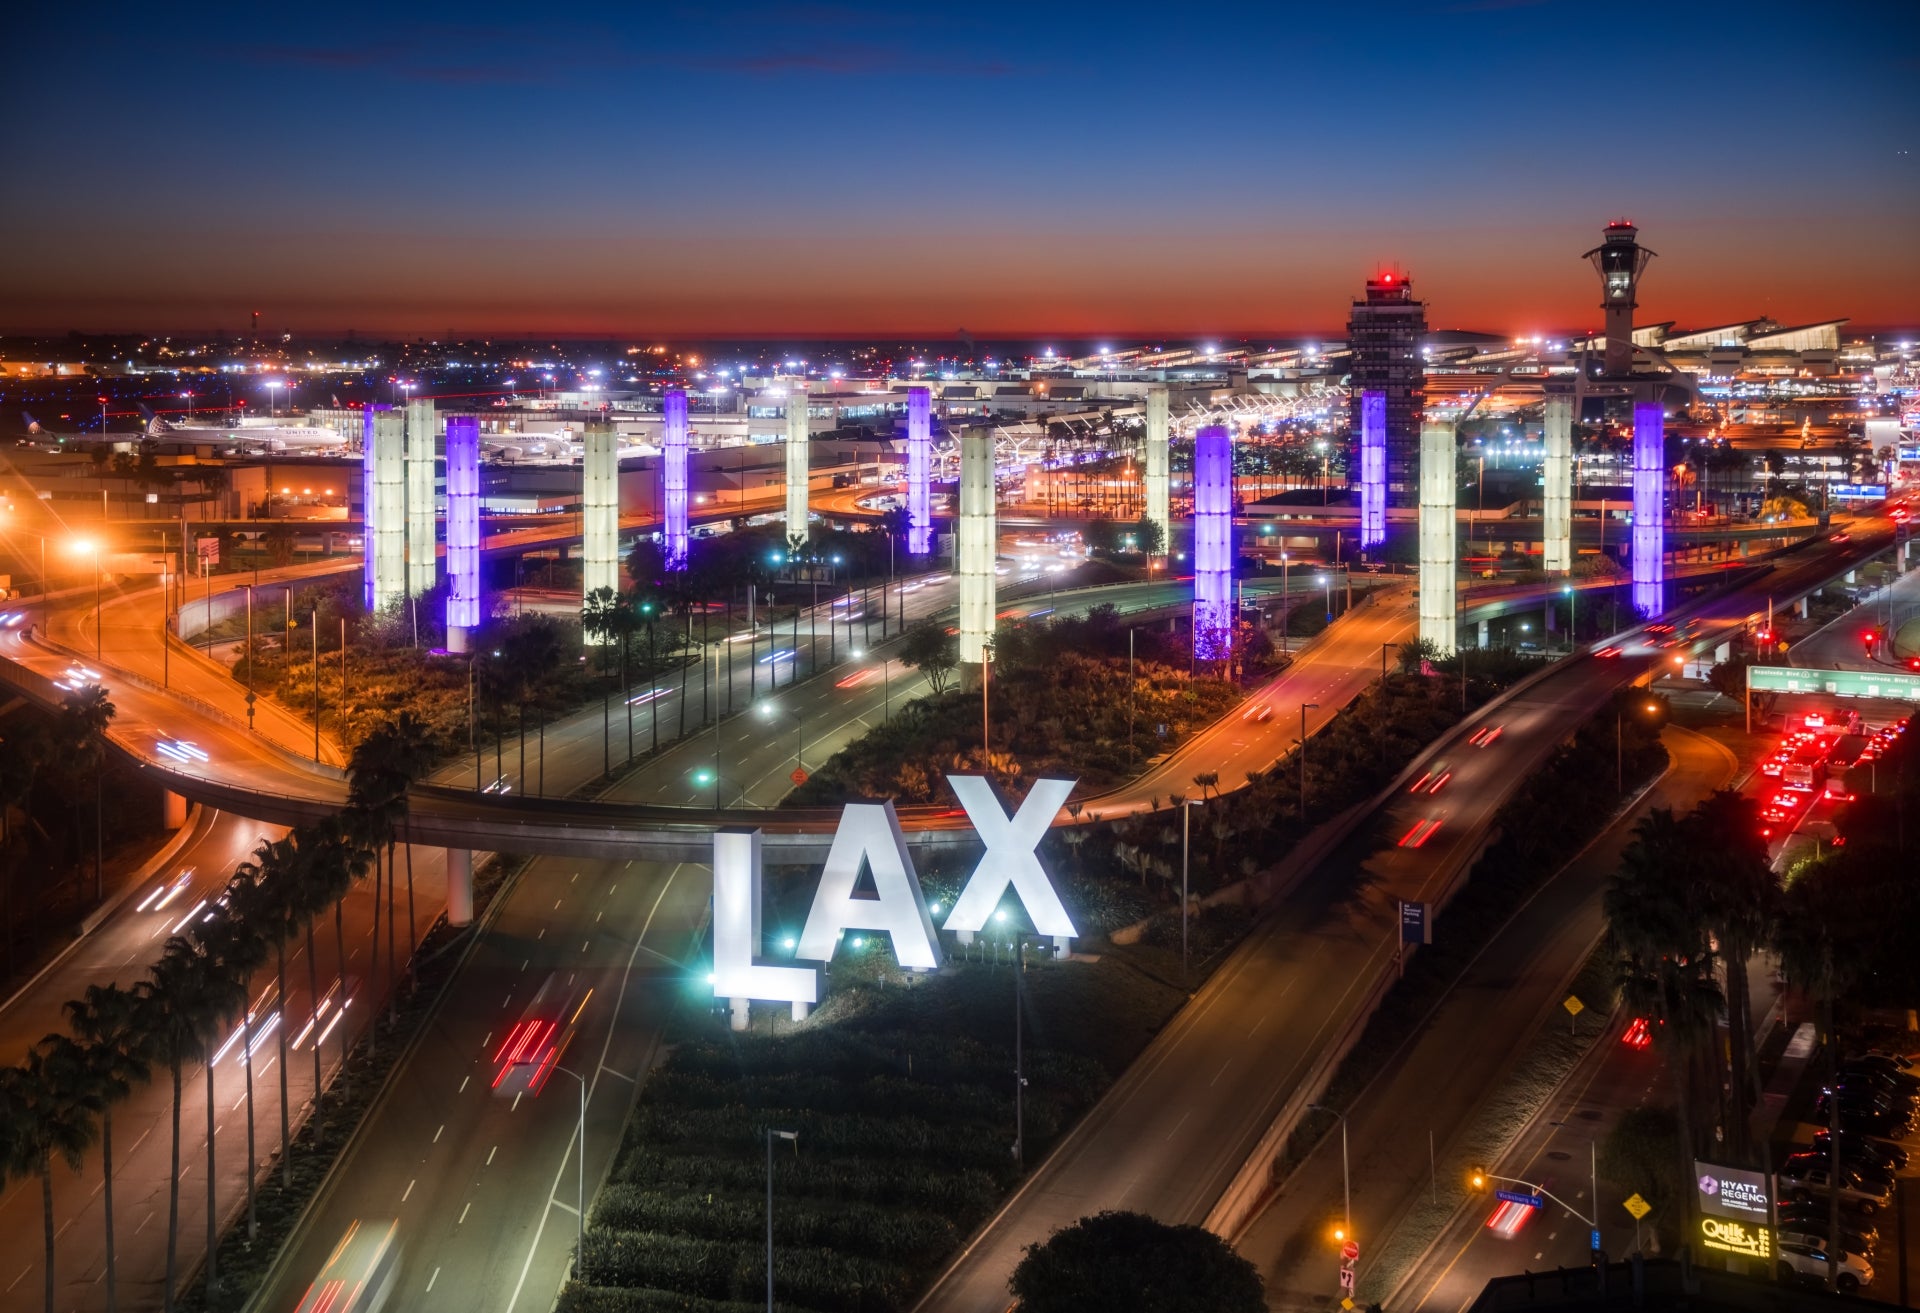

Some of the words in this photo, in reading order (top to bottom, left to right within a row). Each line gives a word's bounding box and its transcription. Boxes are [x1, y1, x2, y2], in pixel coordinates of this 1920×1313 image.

[713, 774, 1079, 1004] LAX
[1721, 1180, 1758, 1194] HYATT
[1498, 1192, 1529, 1204] Vicksburg
[1721, 1188, 1767, 1204] REGENCY
[1702, 1219, 1745, 1240] Quik
